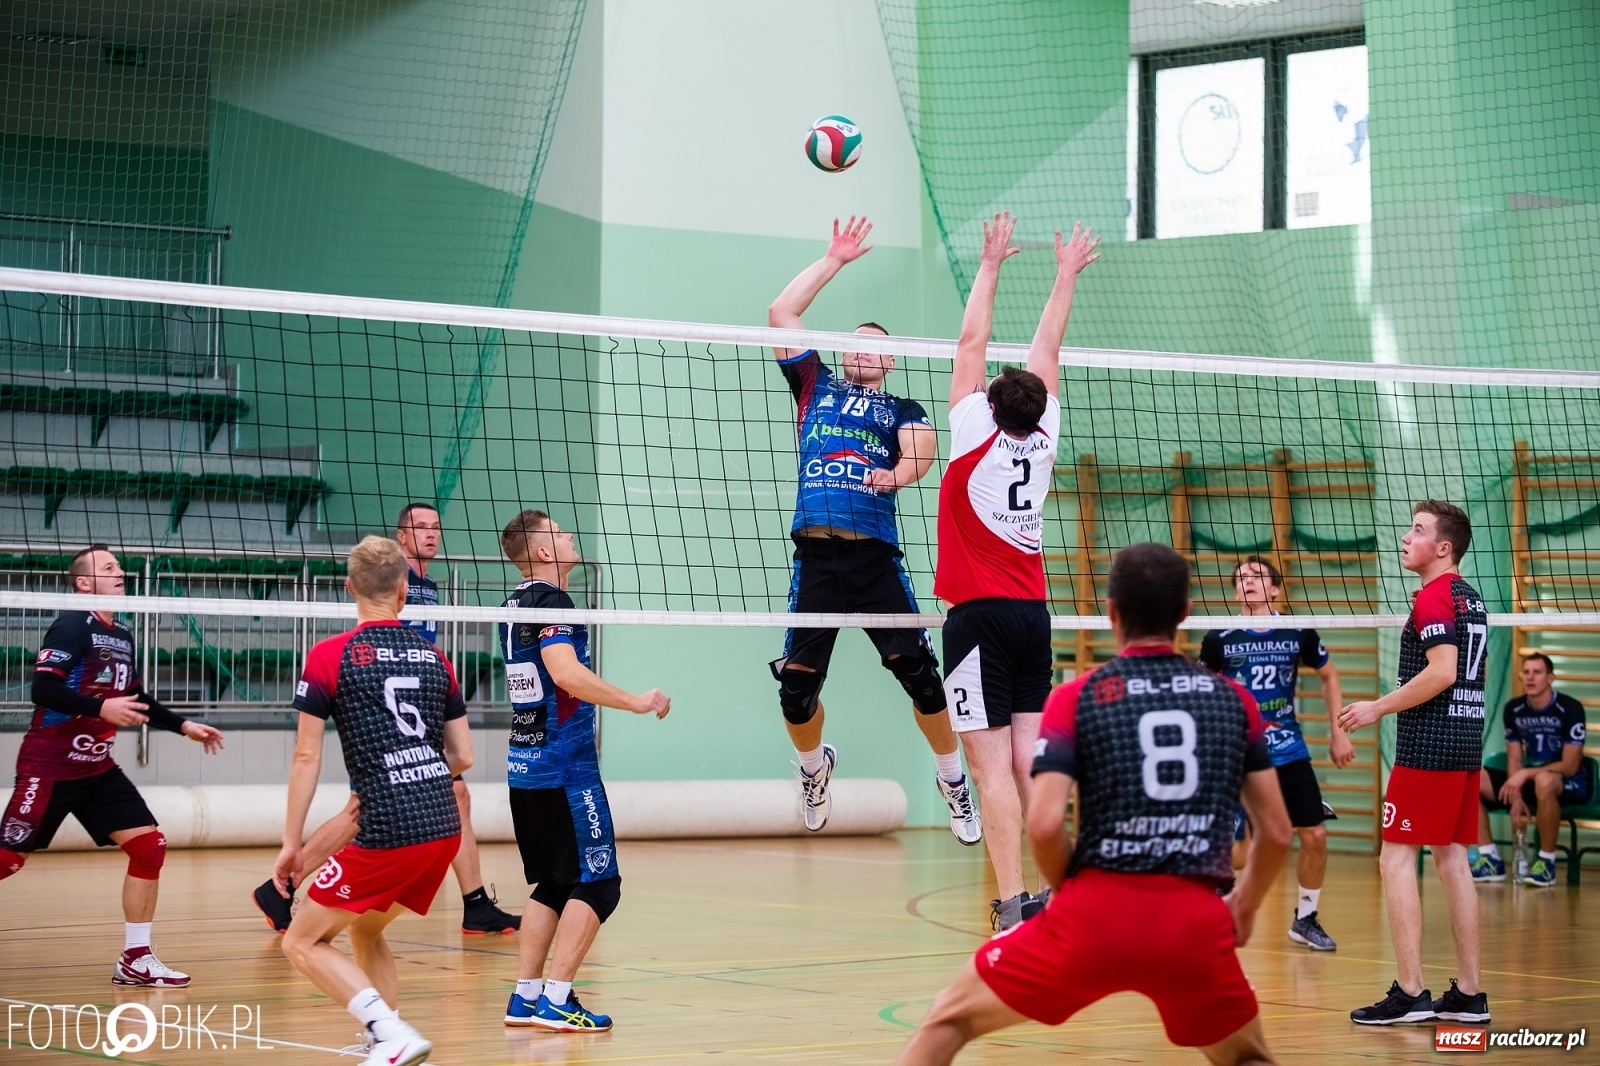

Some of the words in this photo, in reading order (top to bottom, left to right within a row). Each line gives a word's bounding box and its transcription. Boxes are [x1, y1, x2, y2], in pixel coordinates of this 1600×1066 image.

[1008, 458, 1033, 511] 2
[1223, 640, 1300, 656] RESTAURACJA
[114, 662, 128, 691] 13
[1251, 665, 1277, 690] 22
[954, 687, 970, 717] 2
[1138, 709, 1199, 801] 8
